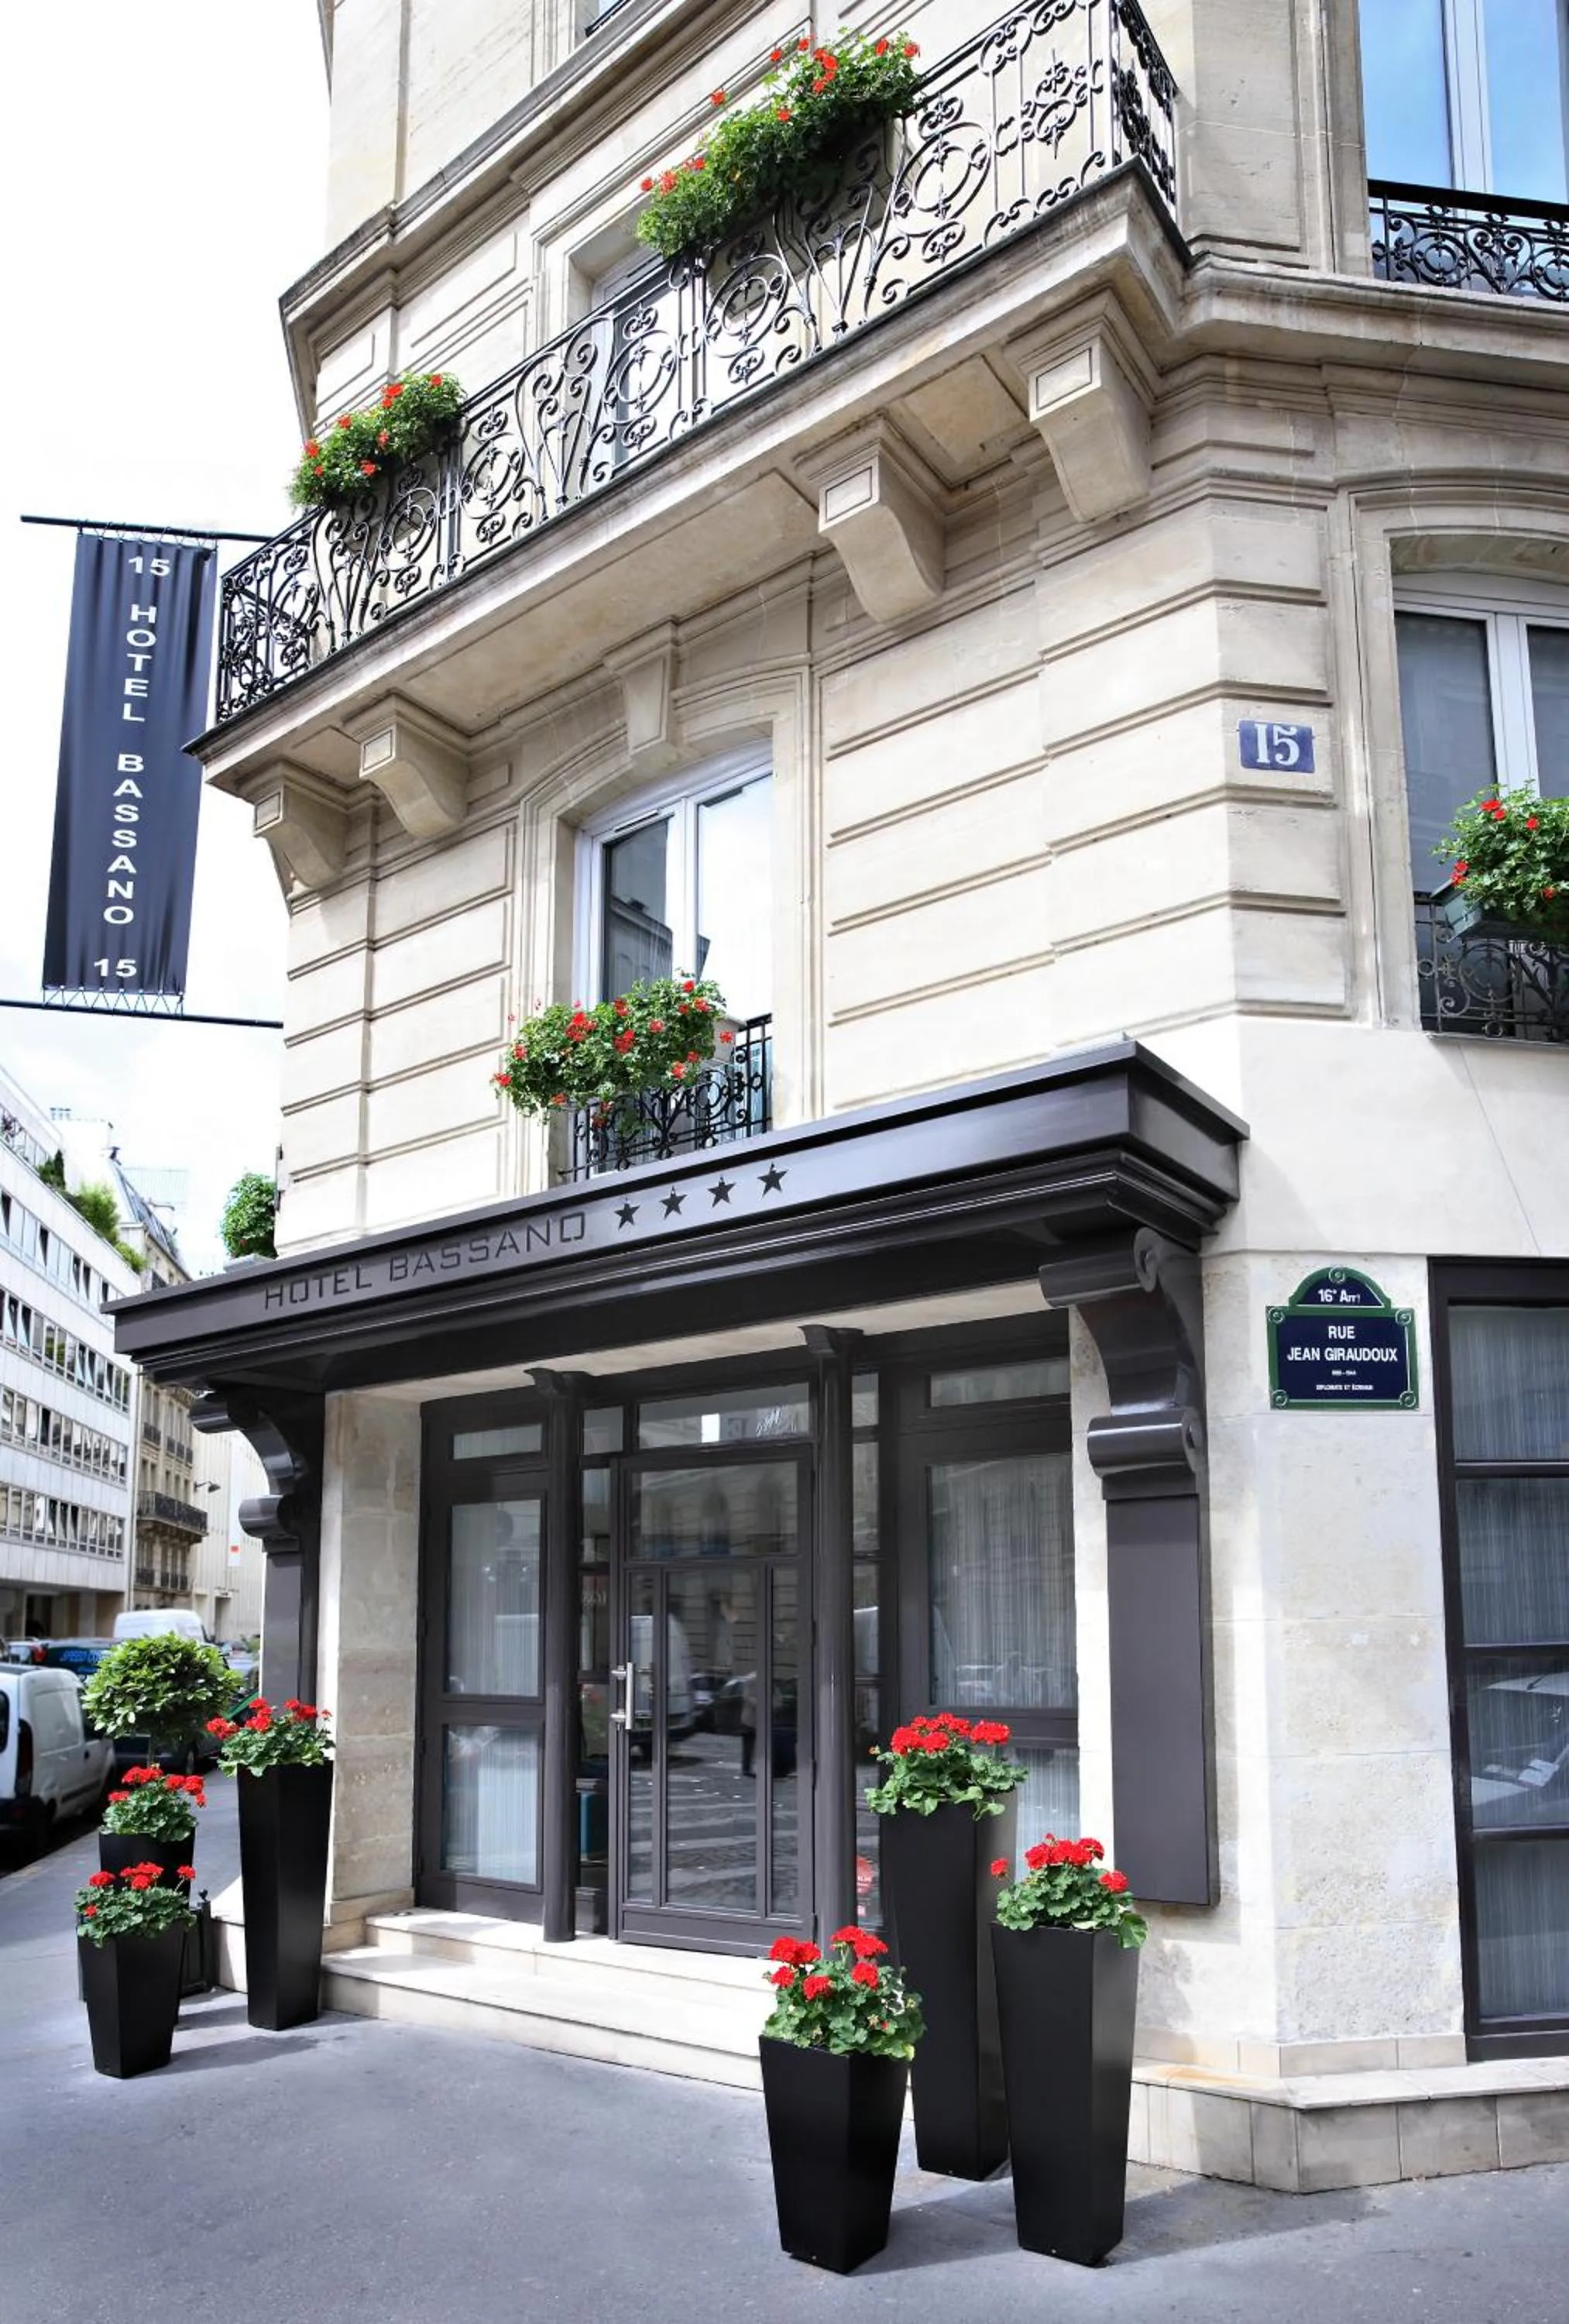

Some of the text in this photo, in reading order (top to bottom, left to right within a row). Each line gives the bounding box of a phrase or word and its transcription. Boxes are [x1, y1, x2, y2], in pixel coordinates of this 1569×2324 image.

[1255, 724, 1300, 766] 15
[94, 556, 171, 978] 15 HOTEL BASSANO 15
[265, 1212, 585, 1310] HOTEL BASSANO
[1327, 1325, 1356, 1339] RUE
[1286, 1347, 1398, 1362] JEAN GIRAUDOUX
